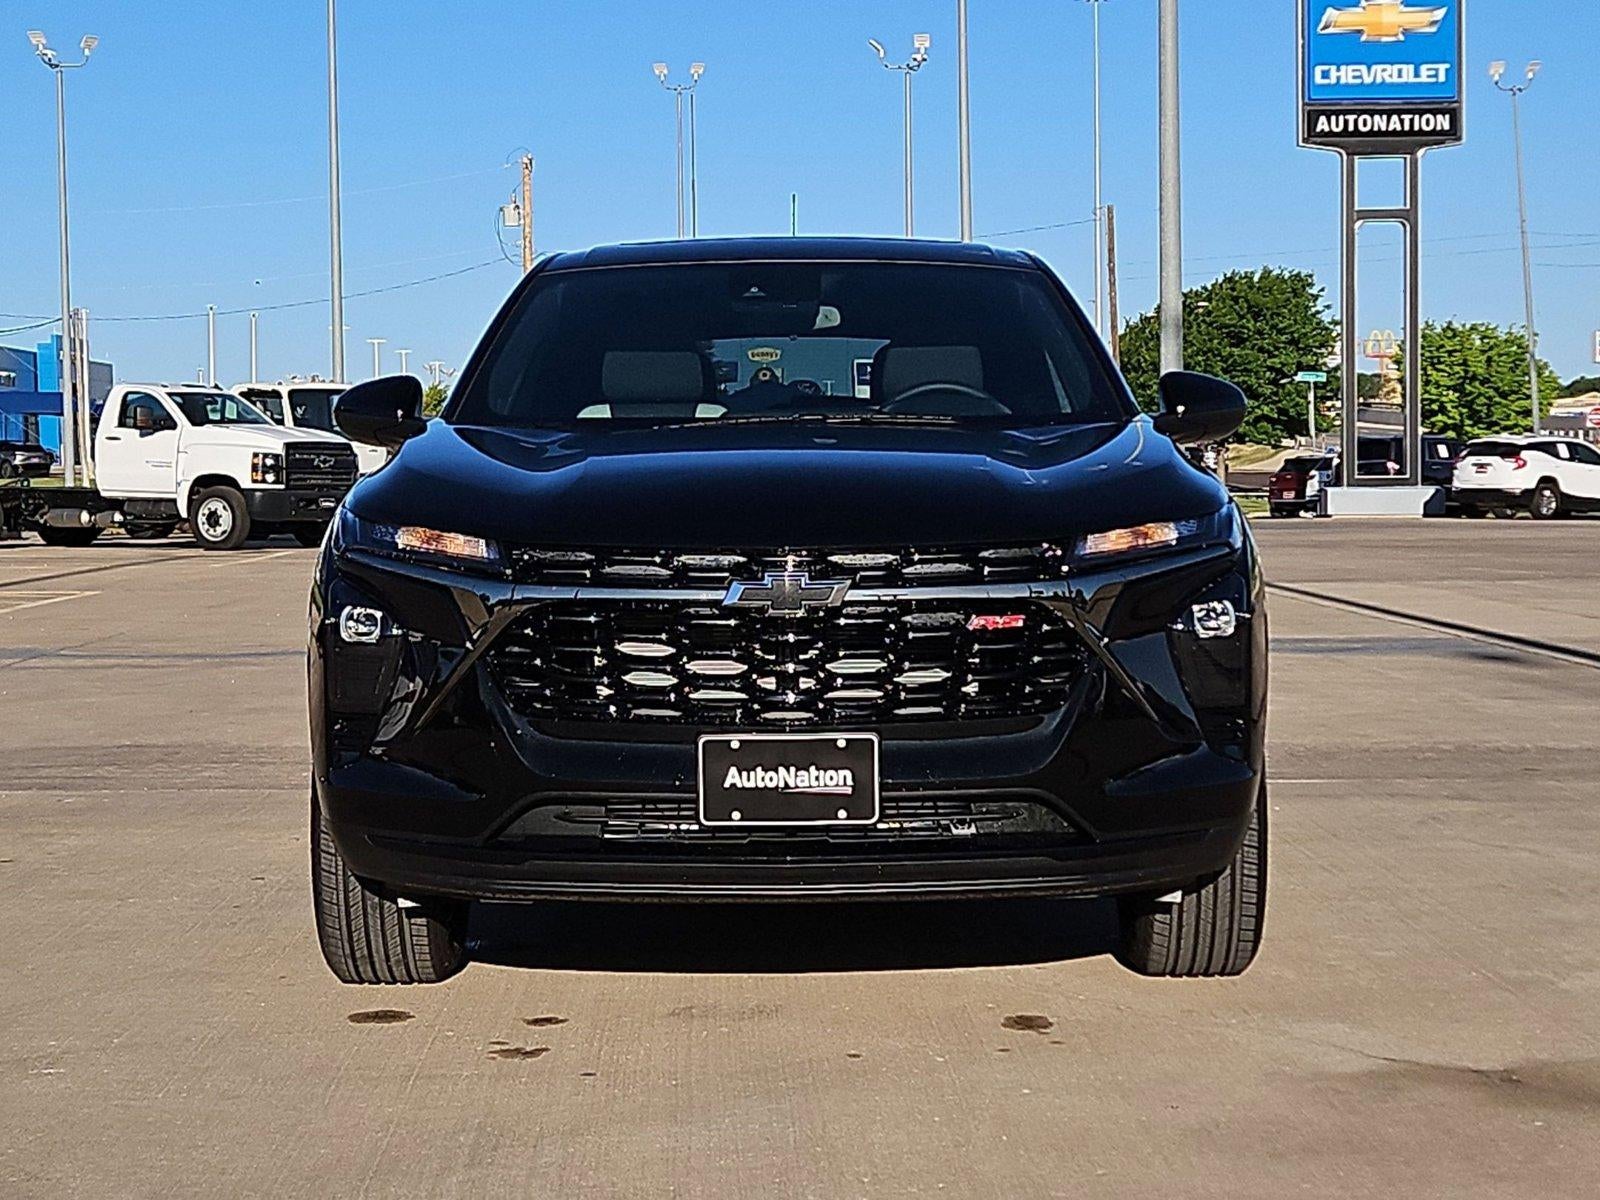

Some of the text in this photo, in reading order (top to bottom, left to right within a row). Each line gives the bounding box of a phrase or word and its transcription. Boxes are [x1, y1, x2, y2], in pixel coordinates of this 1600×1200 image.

[1314, 64, 1450, 84] CHEVROLET
[1315, 113, 1451, 133] AUTONATION
[723, 765, 854, 789] AutoNation
